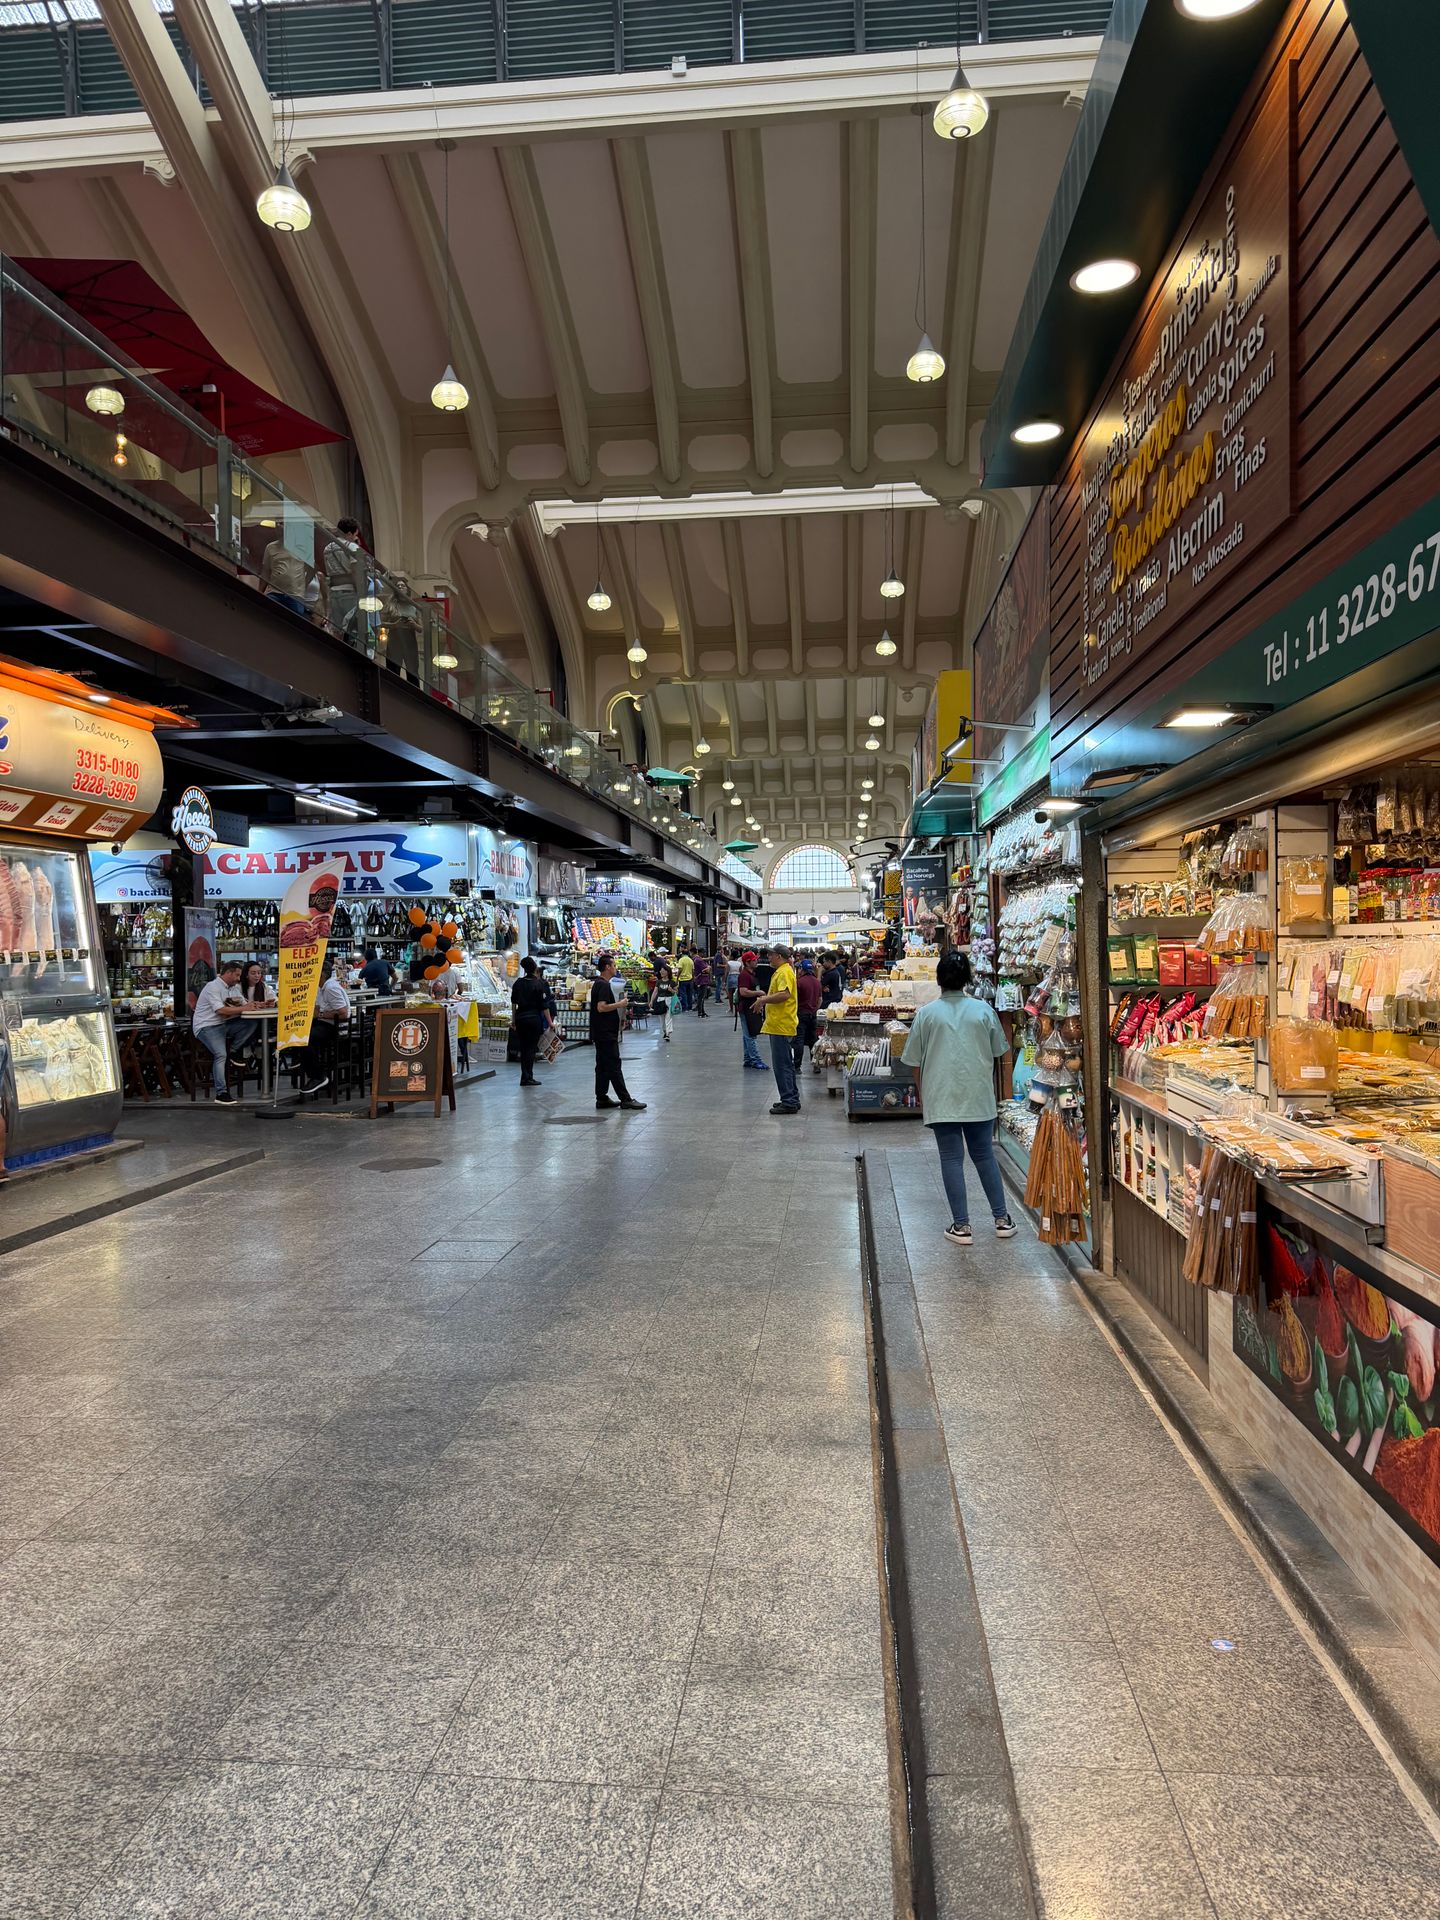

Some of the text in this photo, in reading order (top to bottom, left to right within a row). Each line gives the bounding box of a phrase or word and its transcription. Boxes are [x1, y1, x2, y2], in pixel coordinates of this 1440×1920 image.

[1161, 239, 1224, 373] Pimenta
[1161, 349, 1187, 401] Coentro
[1187, 311, 1224, 387] Curry
[1218, 314, 1265, 403] Spices
[1128, 377, 1141, 412] Tea
[1131, 387, 1157, 448] Garlic
[1187, 374, 1217, 431] Cebola
[1222, 350, 1275, 439] Chimichurri
[1216, 427, 1245, 481] Ervas
[1235, 437, 1266, 491] Finas
[1087, 496, 1109, 546] Herbs
[1111, 431, 1215, 595] Brasileiros
[1167, 490, 1224, 583] Alecrim
[1089, 532, 1108, 572] Sugar
[1093, 560, 1112, 597] Pepper
[1192, 521, 1243, 587] Noz-Moscada
[1096, 597, 1124, 650] Canela
[1134, 584, 1167, 635] Traditional
[1306, 607, 1330, 663] 11
[1087, 646, 1109, 687] Natural
[72, 771, 137, 801] 3228-3979
[76, 748, 140, 780] 3315-0180
